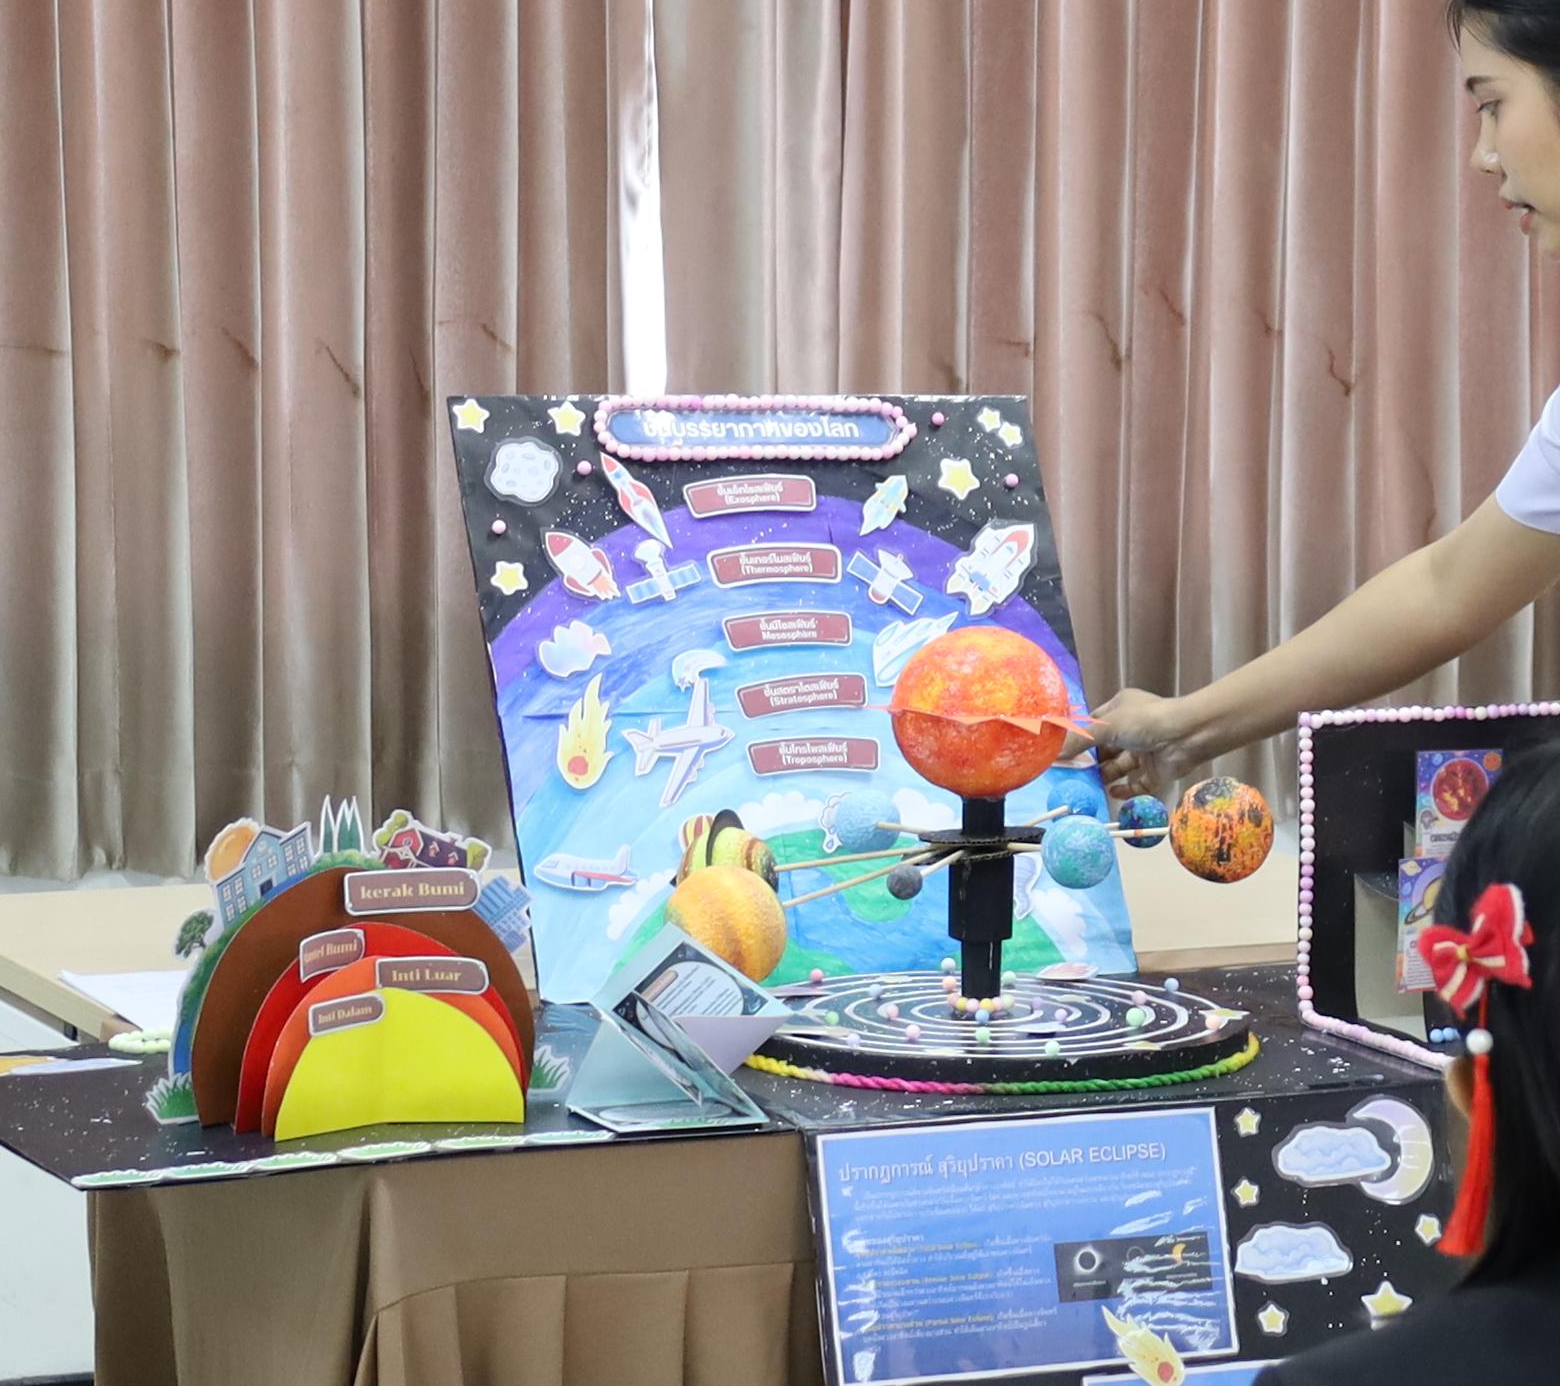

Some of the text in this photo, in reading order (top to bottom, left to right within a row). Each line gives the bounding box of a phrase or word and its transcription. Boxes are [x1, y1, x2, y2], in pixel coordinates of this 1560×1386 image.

[741, 563, 813, 575] (Thermosphere)
[770, 690, 837, 707] (Stratosphere)
[782, 753, 848, 765] (Troposphere)
[360, 882, 465, 900] kerak Bumi
[392, 968, 461, 982] Inti Luar
[318, 1011, 336, 1025] Inti
[1019, 1147, 1083, 1169] (SOLAR
[1089, 1142, 1166, 1163] ECLIPSE)
